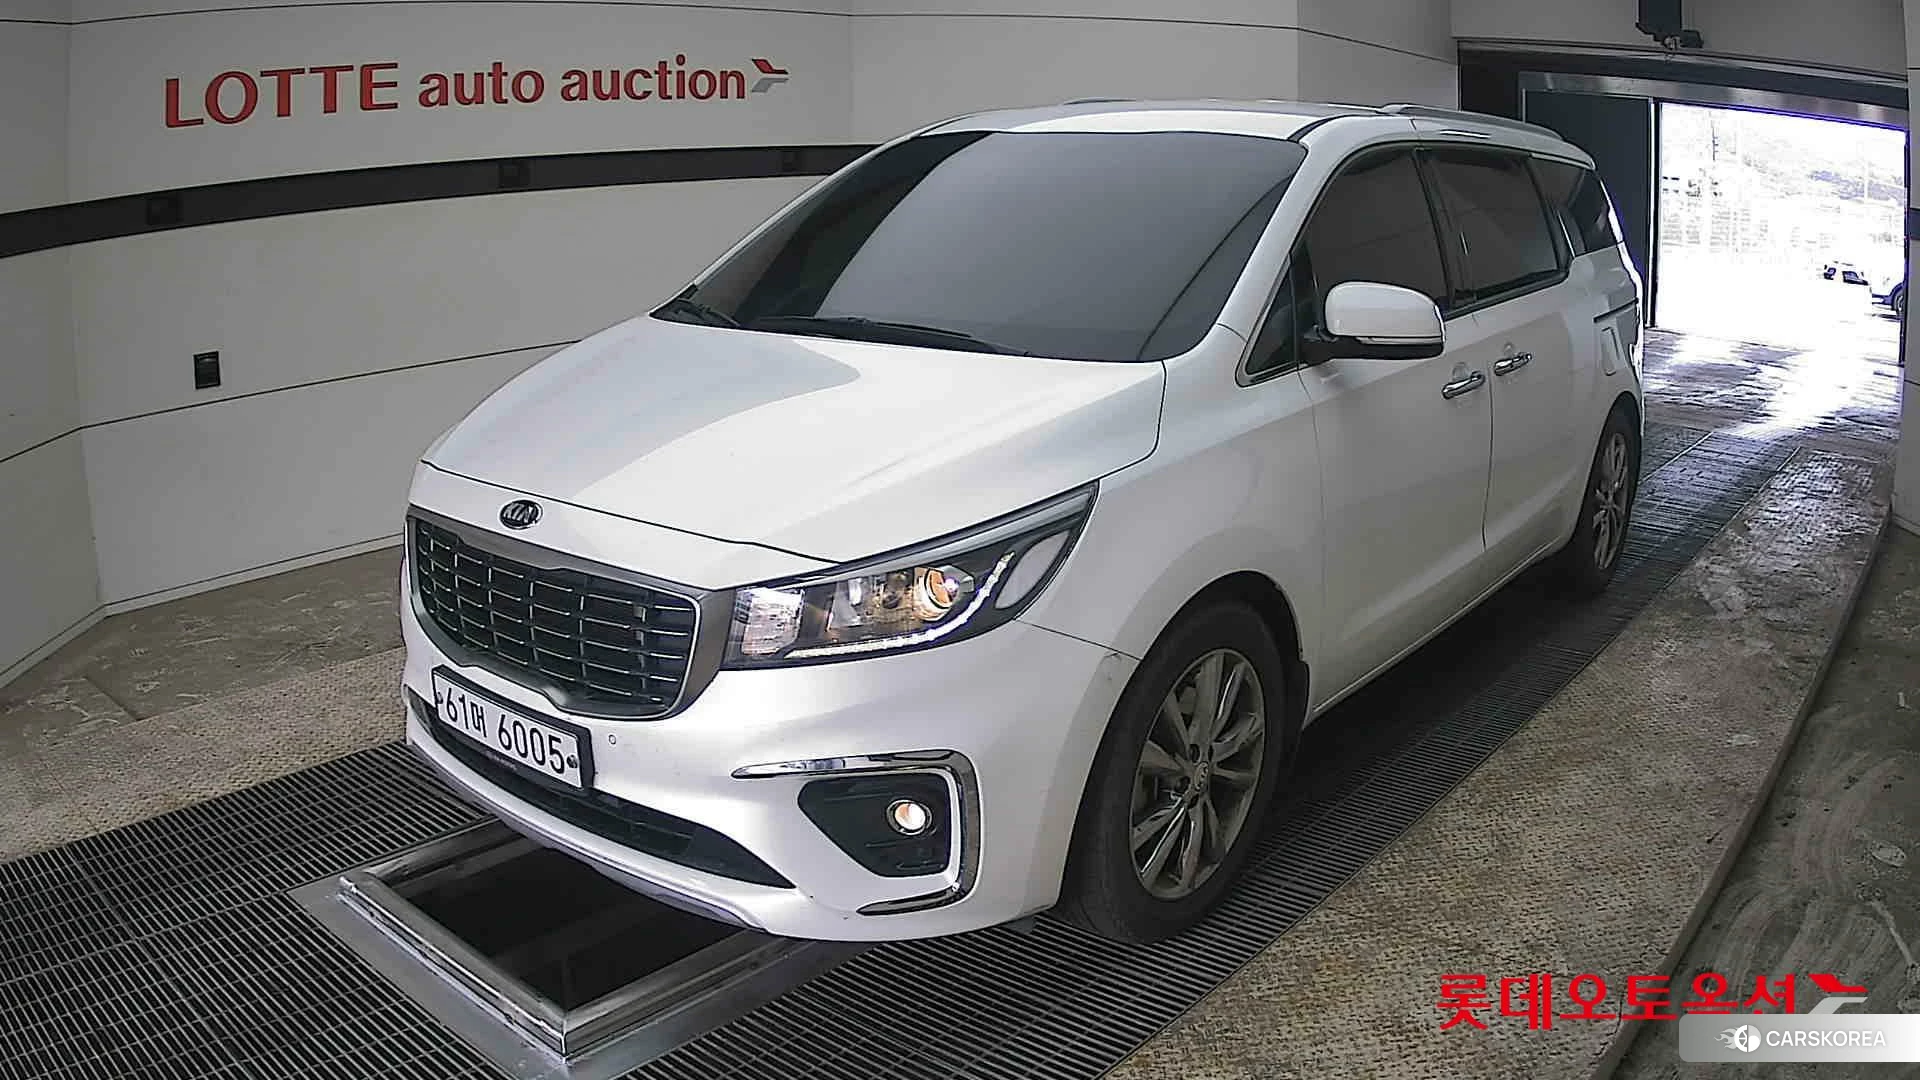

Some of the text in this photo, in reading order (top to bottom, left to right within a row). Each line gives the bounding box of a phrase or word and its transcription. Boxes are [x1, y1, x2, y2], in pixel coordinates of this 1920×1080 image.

[165, 54, 746, 128] LOTTE auto auction
[446, 687, 565, 774] 61머 6005
